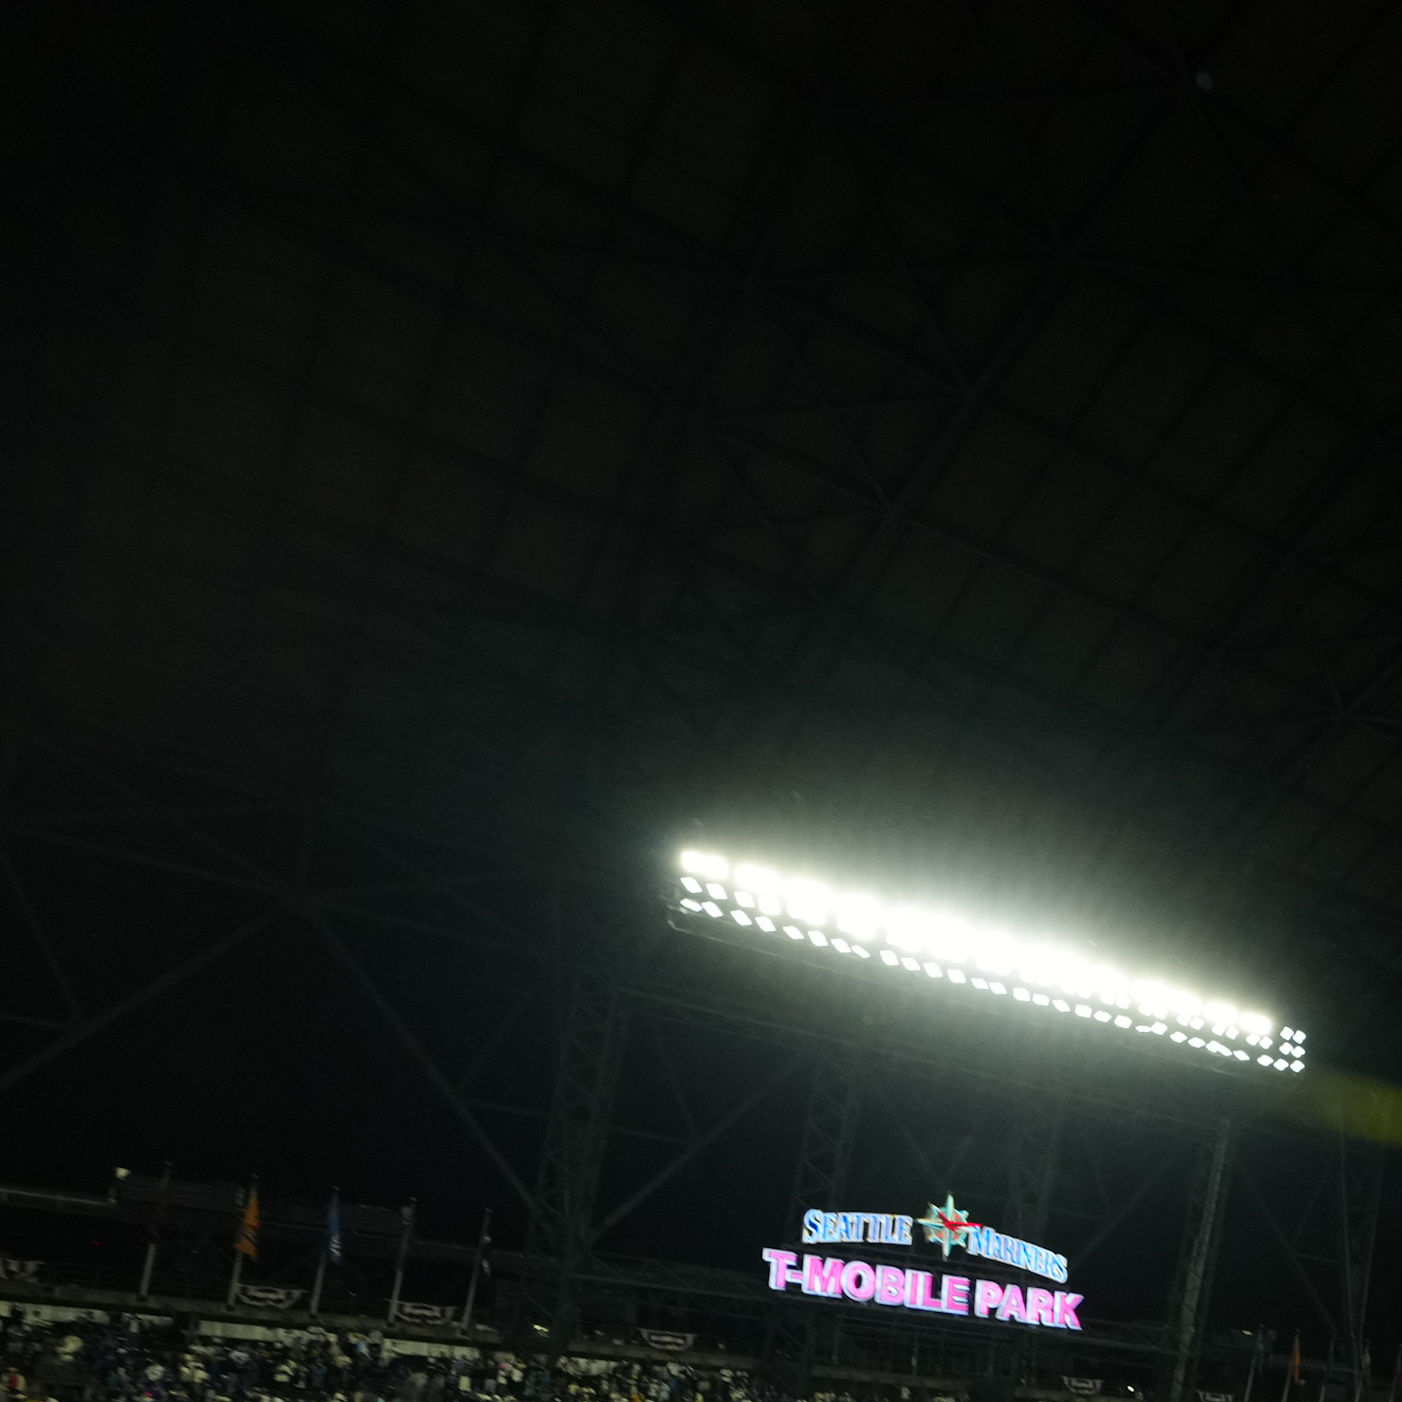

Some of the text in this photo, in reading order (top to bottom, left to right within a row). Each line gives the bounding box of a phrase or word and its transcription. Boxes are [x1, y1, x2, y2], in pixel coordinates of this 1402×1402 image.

[802, 1208, 1069, 1284] SEATTLE MARINERS
[762, 1247, 1085, 1331] T-MOBILE PARK
